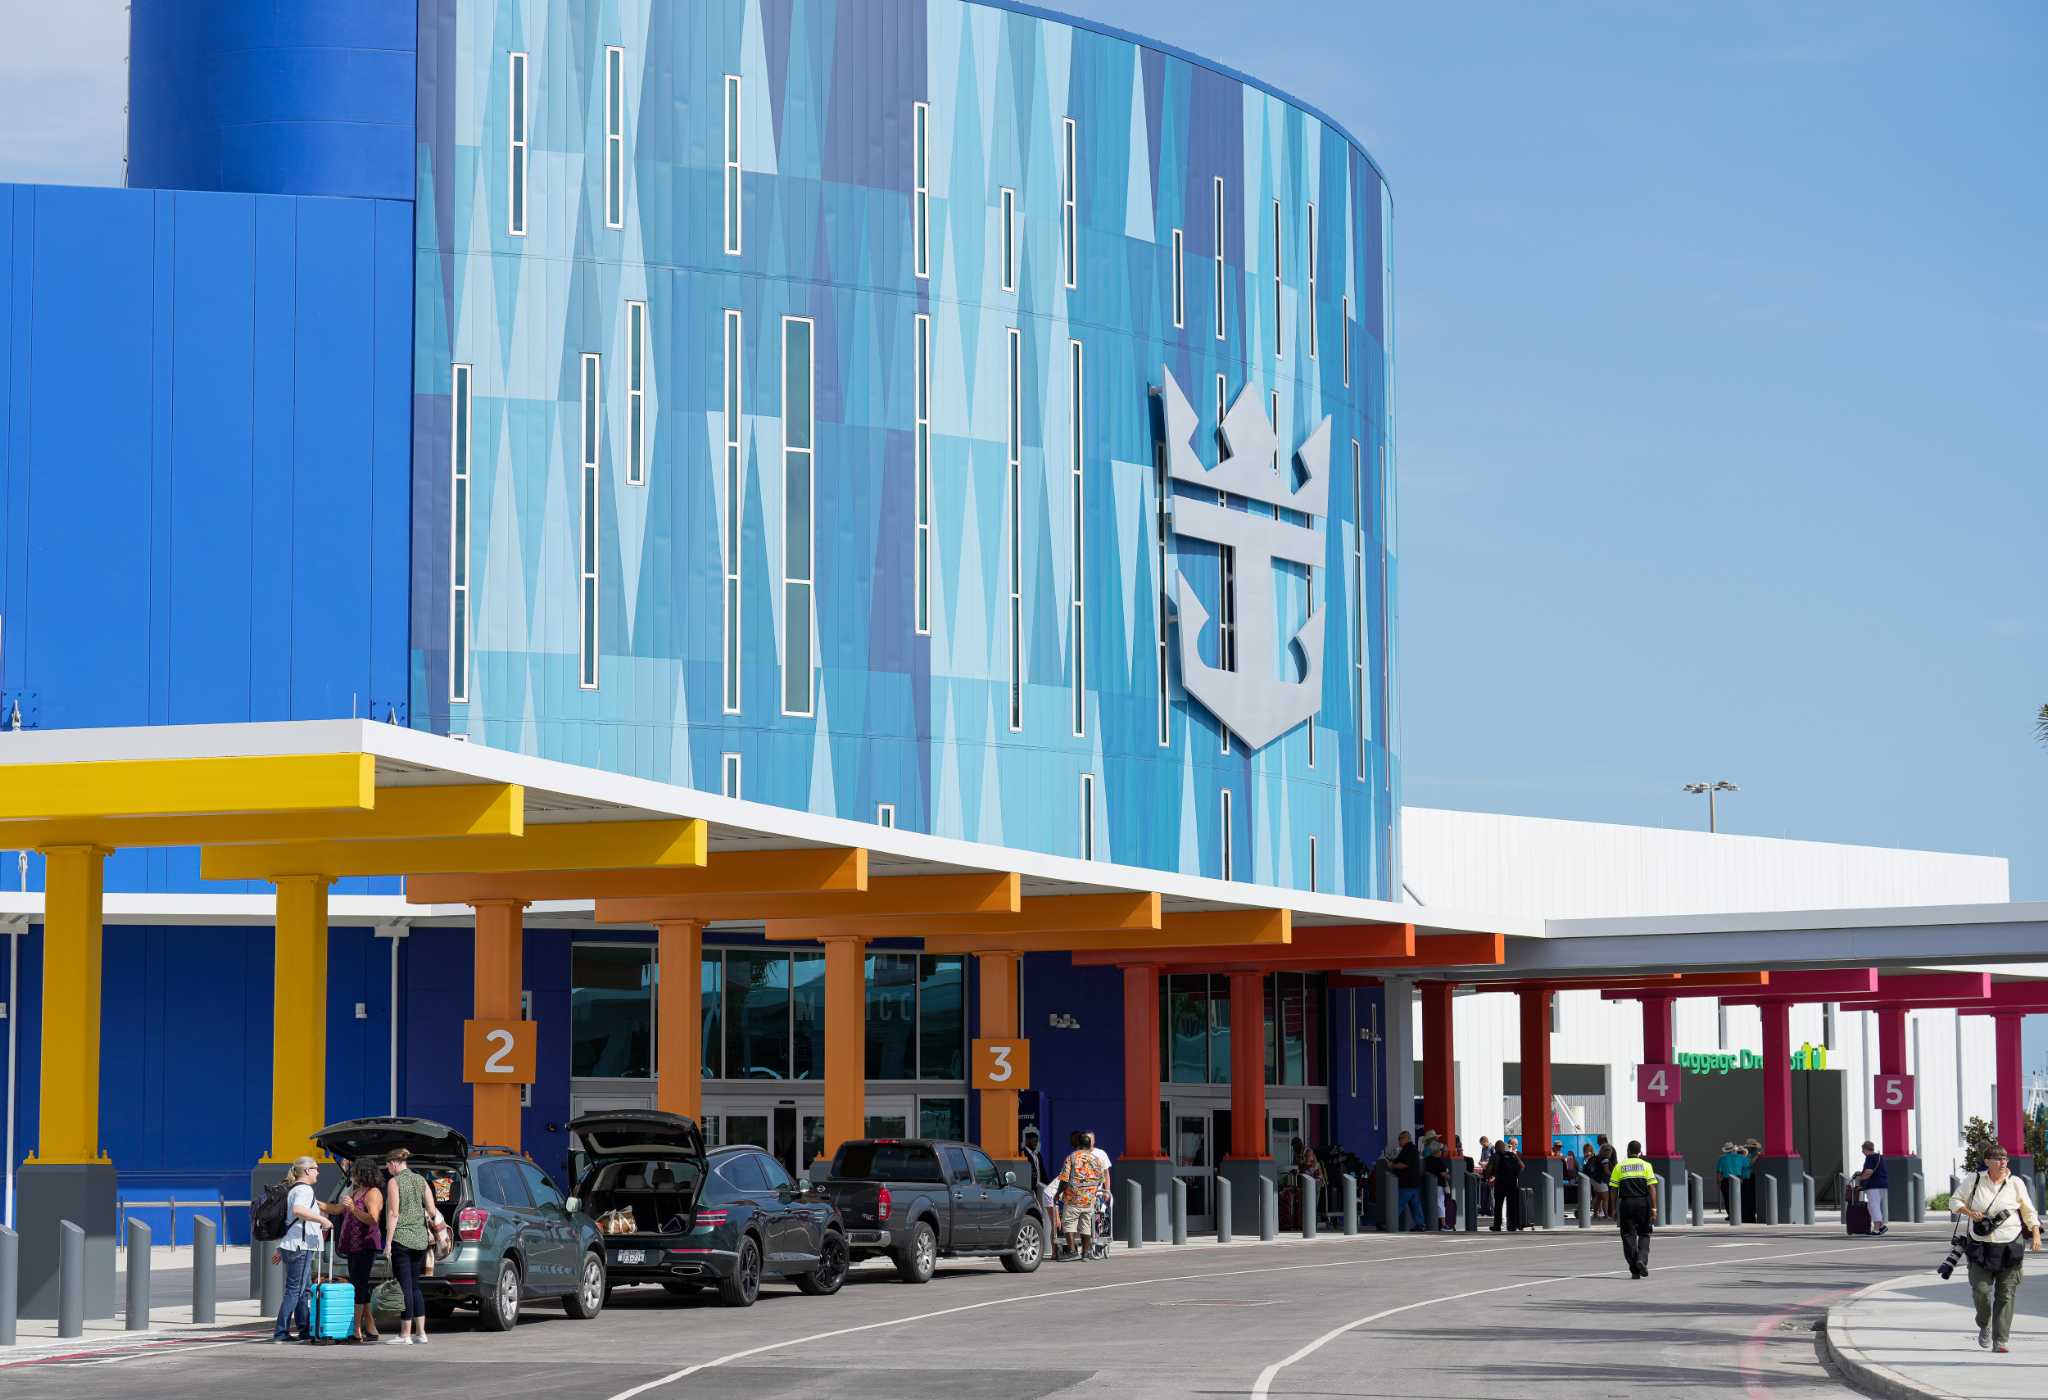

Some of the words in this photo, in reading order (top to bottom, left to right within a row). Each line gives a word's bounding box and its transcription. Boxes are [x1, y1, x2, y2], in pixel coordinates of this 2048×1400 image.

[485, 1029, 515, 1073] 2
[989, 1046, 1012, 1082] 3
[1647, 1070, 1669, 1097] 4
[1886, 1079, 1904, 1105] 5
